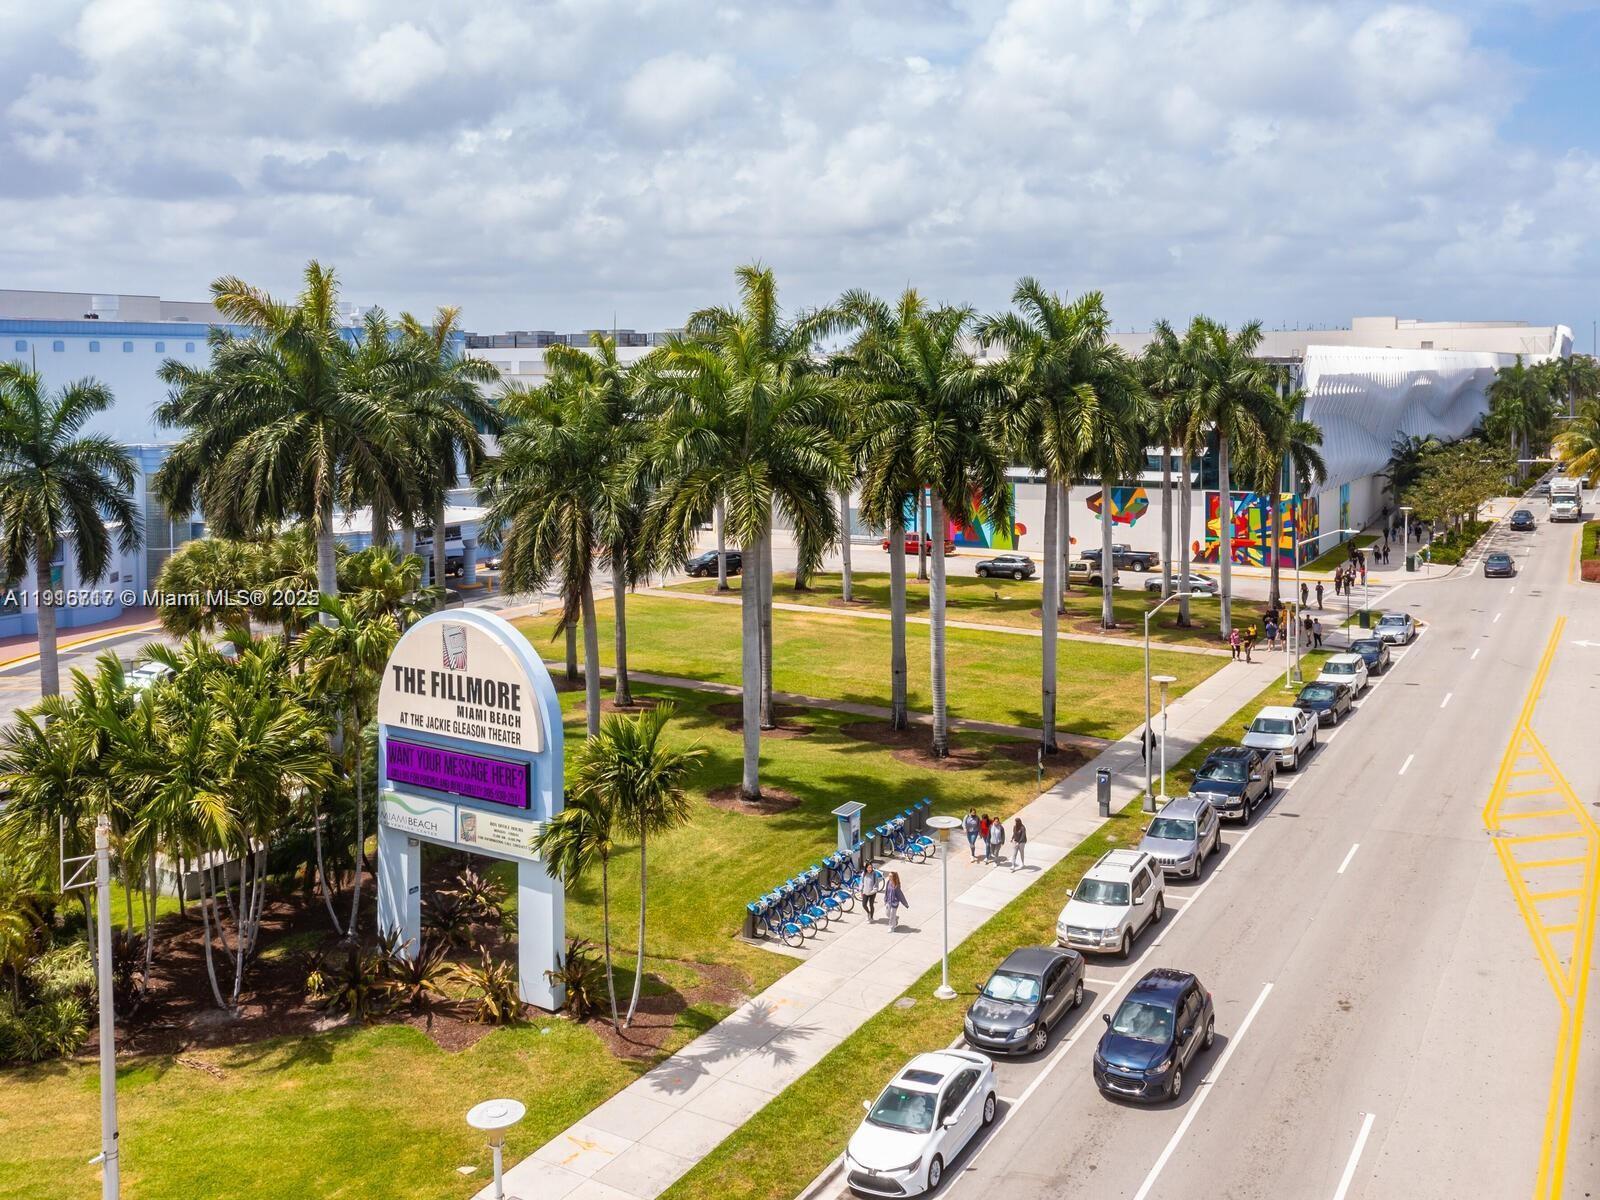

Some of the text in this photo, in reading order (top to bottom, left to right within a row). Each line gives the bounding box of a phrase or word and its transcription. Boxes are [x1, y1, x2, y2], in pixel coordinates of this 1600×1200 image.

[392, 665, 521, 712] THE FILLMORE
[400, 711, 521, 746] AT THE JACKIE GLEASON THEATER
[456, 705, 521, 729] MIAMI BEACH
[387, 745, 524, 790] WANT YOUR MESSAGE HERE?
